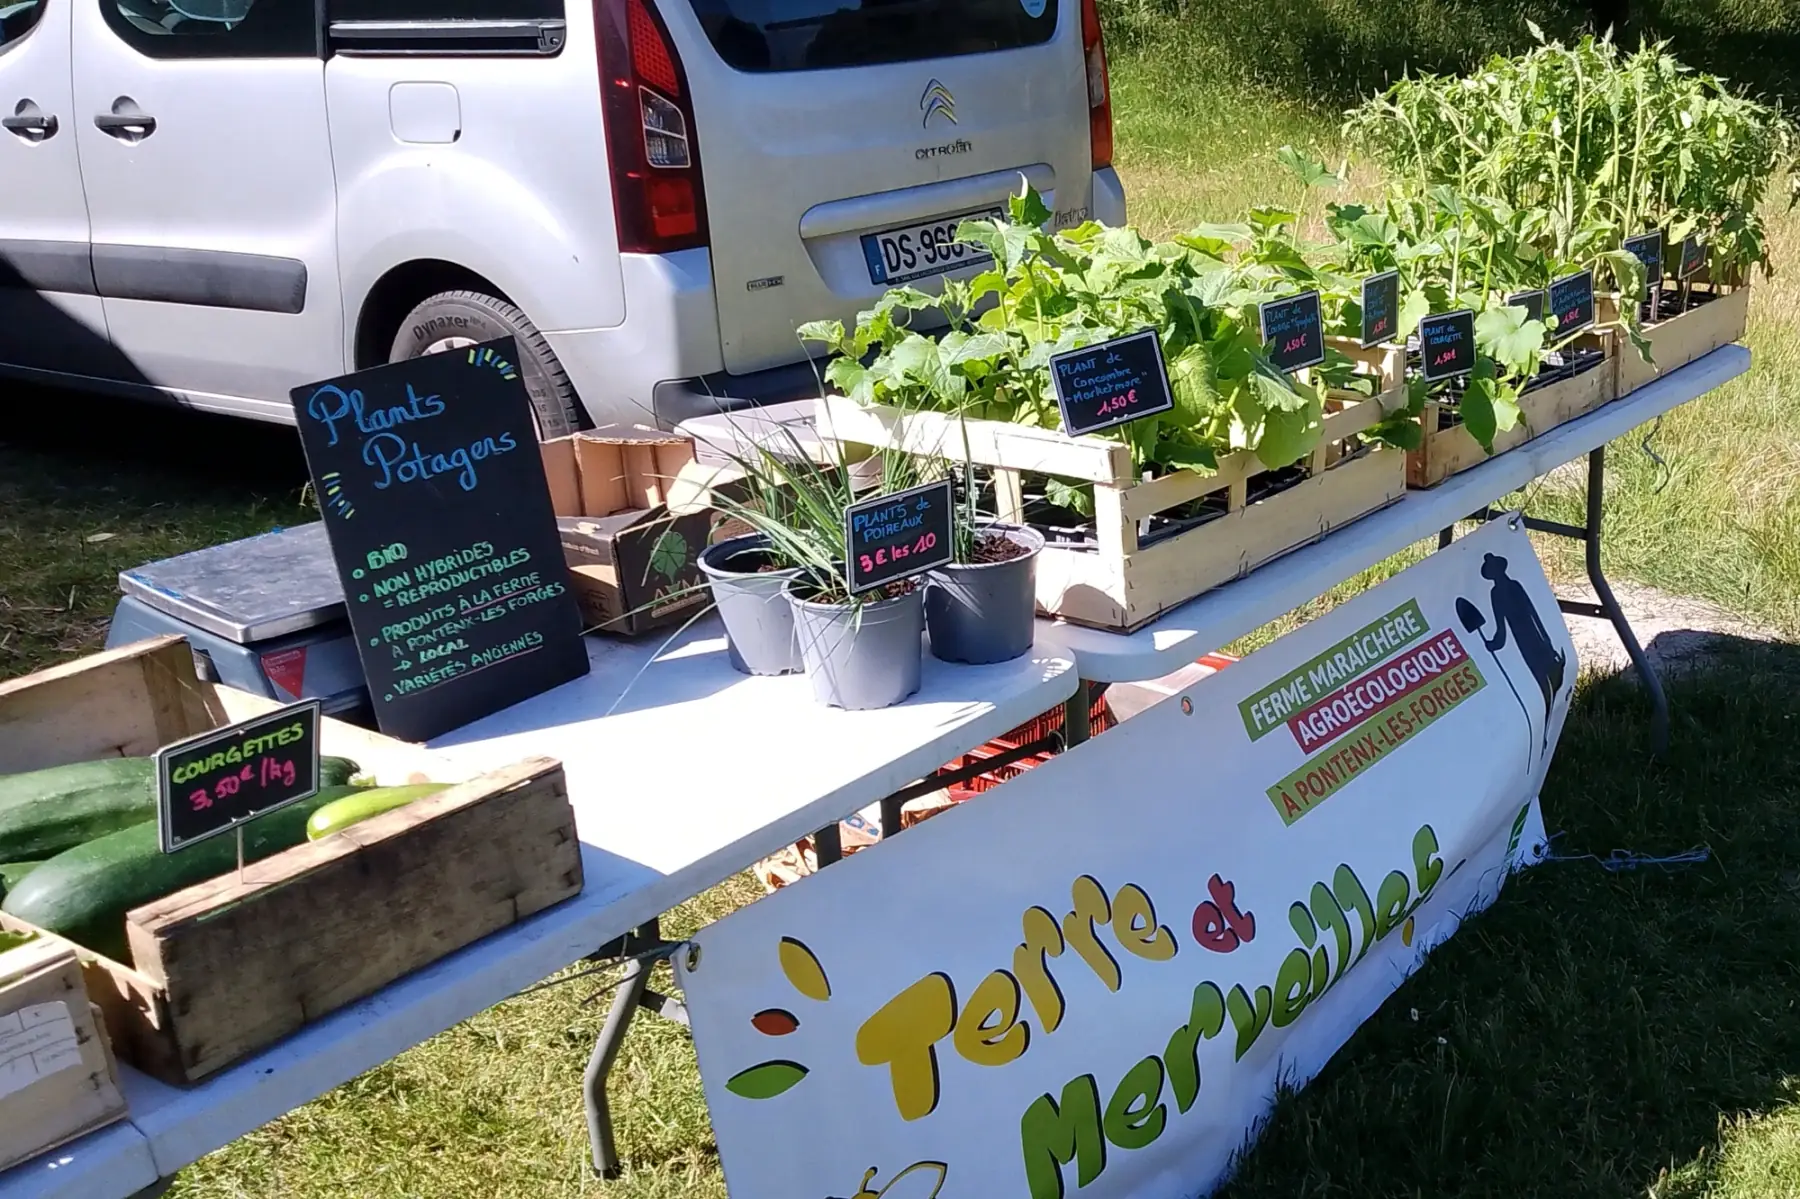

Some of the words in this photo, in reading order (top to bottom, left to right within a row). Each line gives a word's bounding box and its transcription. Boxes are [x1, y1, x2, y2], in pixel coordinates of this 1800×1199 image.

[914, 138, 973, 160] CITROËN
[874, 264, 881, 276] F
[412, 315, 469, 340] Dynaxer
[1058, 357, 1097, 377] PLANT
[1105, 352, 1123, 364] de
[1073, 367, 1132, 388] Concombre
[308, 383, 446, 447] Plants
[363, 431, 517, 492] Potagers
[853, 503, 907, 532] PLANTS
[916, 495, 932, 511] de
[863, 513, 924, 543] POIREAUX
[373, 571, 411, 598] NON
[415, 541, 494, 582] HYBRIDES
[891, 545, 910, 562] les
[912, 532, 937, 554] 10
[396, 548, 531, 607] REPRODUCTIBLES
[507, 582, 566, 610] FORGES
[381, 603, 456, 643] PRODUITS
[472, 589, 492, 605] LA
[419, 638, 470, 664] LOCAL
[1250, 676, 1312, 731] FERME
[1308, 608, 1421, 693] MARAÎCHÈRE
[1296, 634, 1462, 746] AGROÉCOLOGIQUE
[172, 722, 305, 784] COURGETTES
[1275, 784, 1302, 819] À
[1294, 665, 1479, 806] PONTENX-LES-FORGES
[856, 874, 1179, 1121] Terre
[1192, 872, 1257, 954] et
